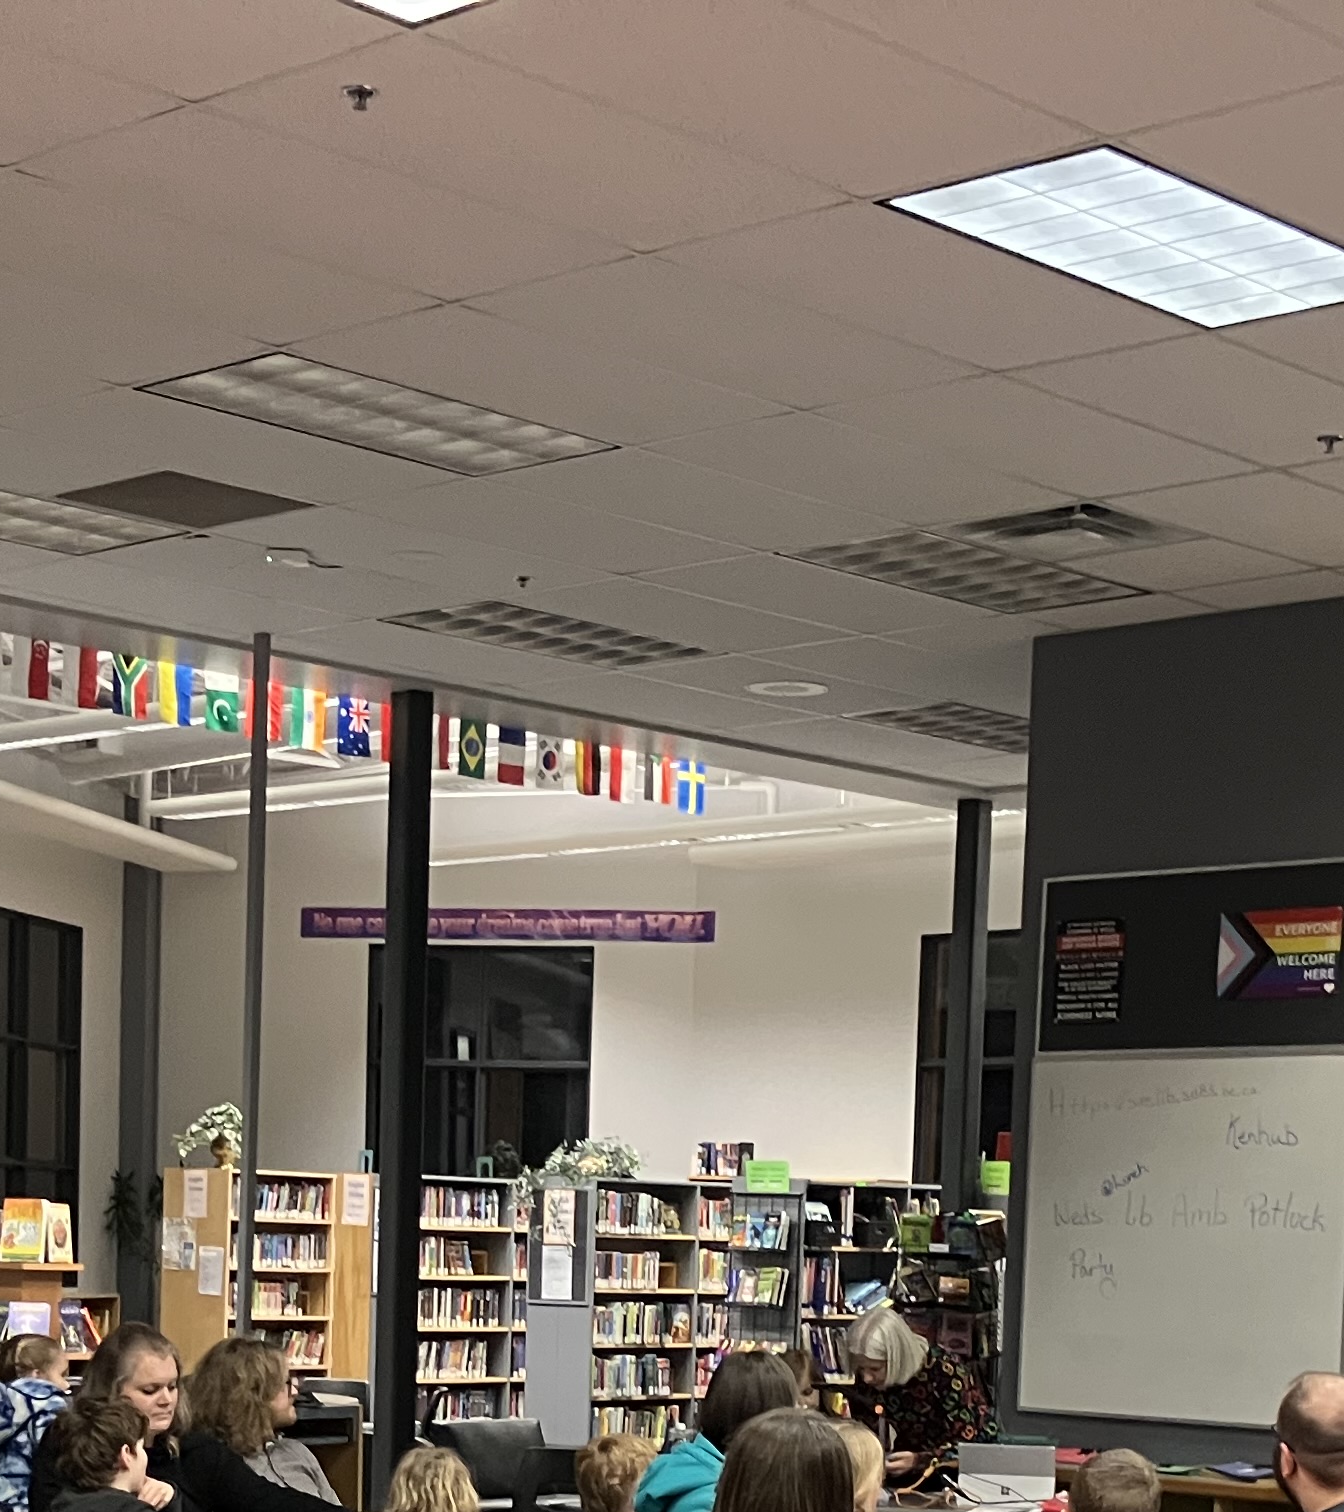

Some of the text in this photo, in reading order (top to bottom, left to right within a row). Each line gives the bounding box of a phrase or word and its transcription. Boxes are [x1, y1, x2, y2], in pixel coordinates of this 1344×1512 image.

[366, 917, 387, 934] ca
[1275, 921, 1337, 936] EVERYONE
[1276, 953, 1335, 966] WELCOME
[1304, 968, 1335, 980] HERE
[1244, 1191, 1326, 1231] Potluck
